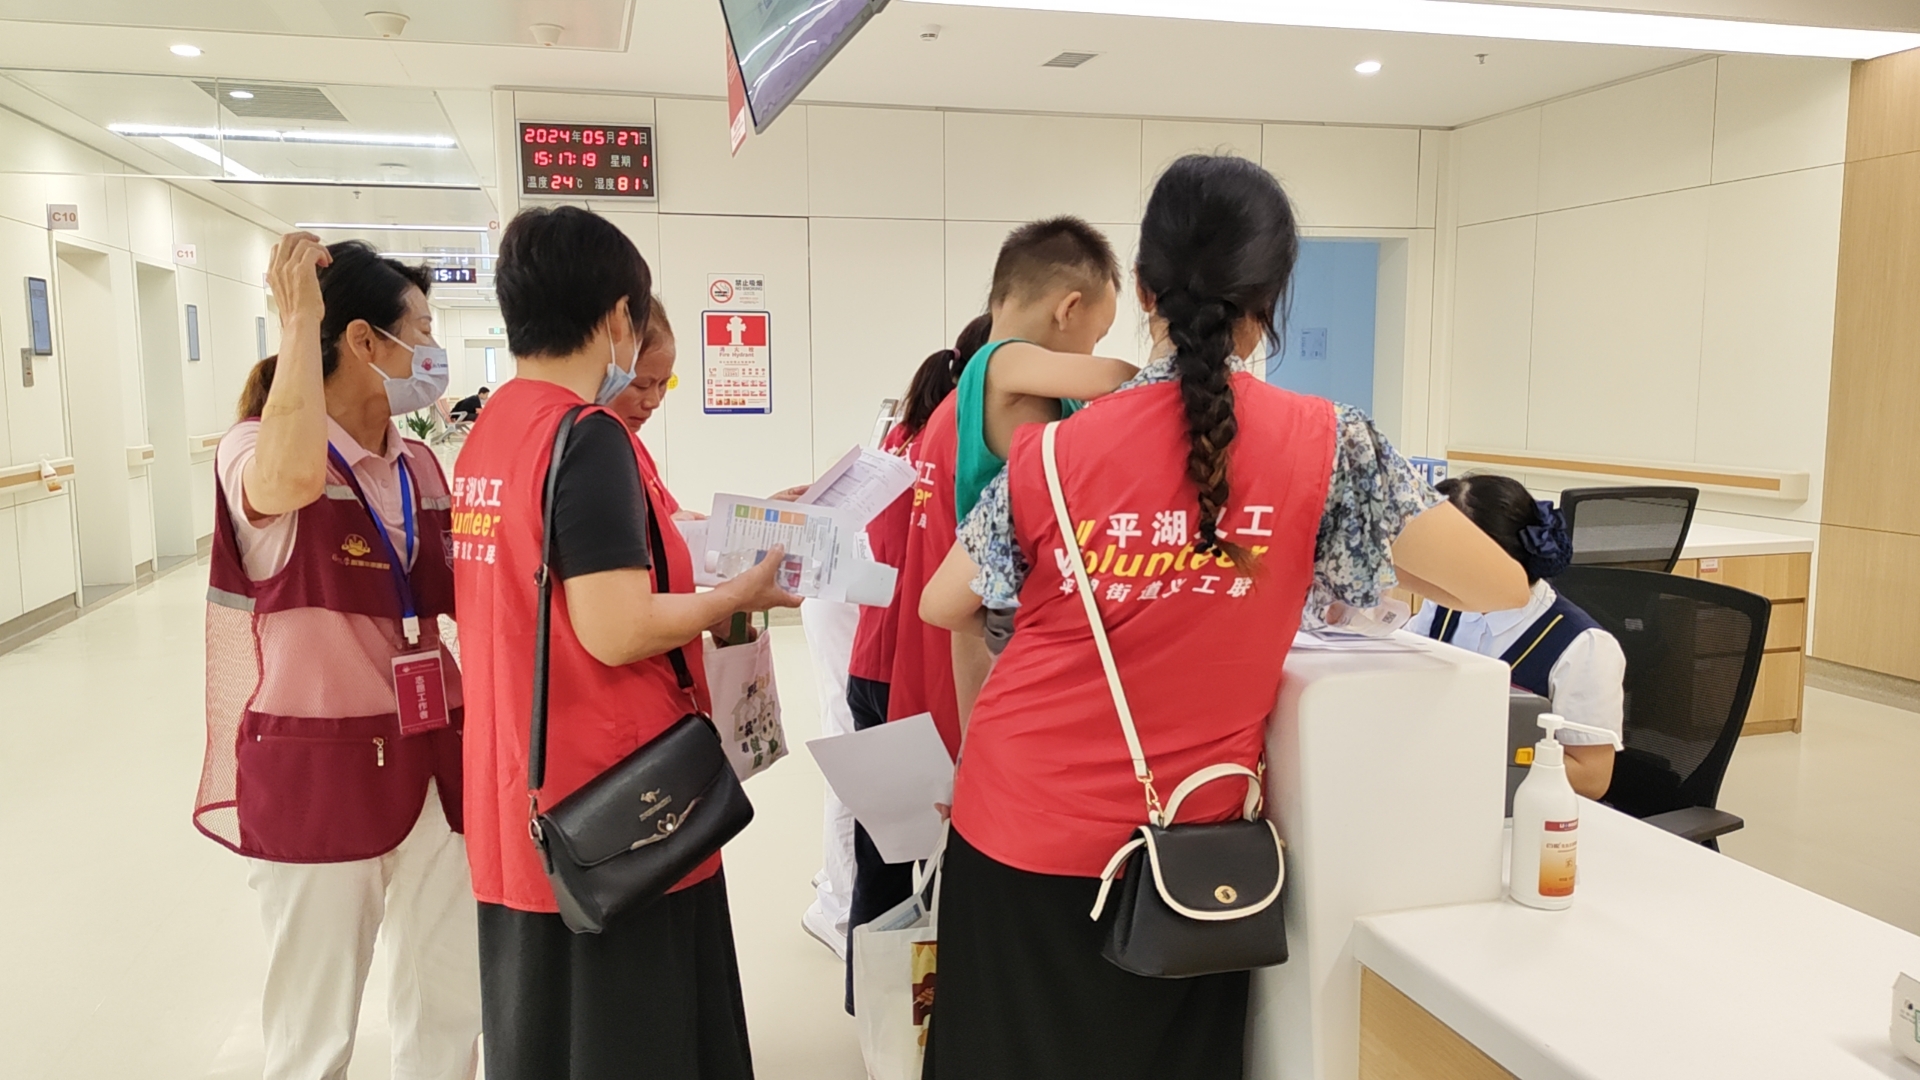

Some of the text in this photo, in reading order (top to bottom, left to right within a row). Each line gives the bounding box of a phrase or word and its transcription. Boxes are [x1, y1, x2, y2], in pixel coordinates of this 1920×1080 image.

[525, 128, 648, 146] 2024年05月27日
[534, 151, 597, 167] 15:17:19
[610, 155, 648, 168] 星期 1
[52, 212, 77, 222] C10
[488, 220, 500, 230] C
[176, 250, 194, 258] C11
[435, 269, 470, 281] 15:17
[415, 675, 428, 720] 志愿工作者
